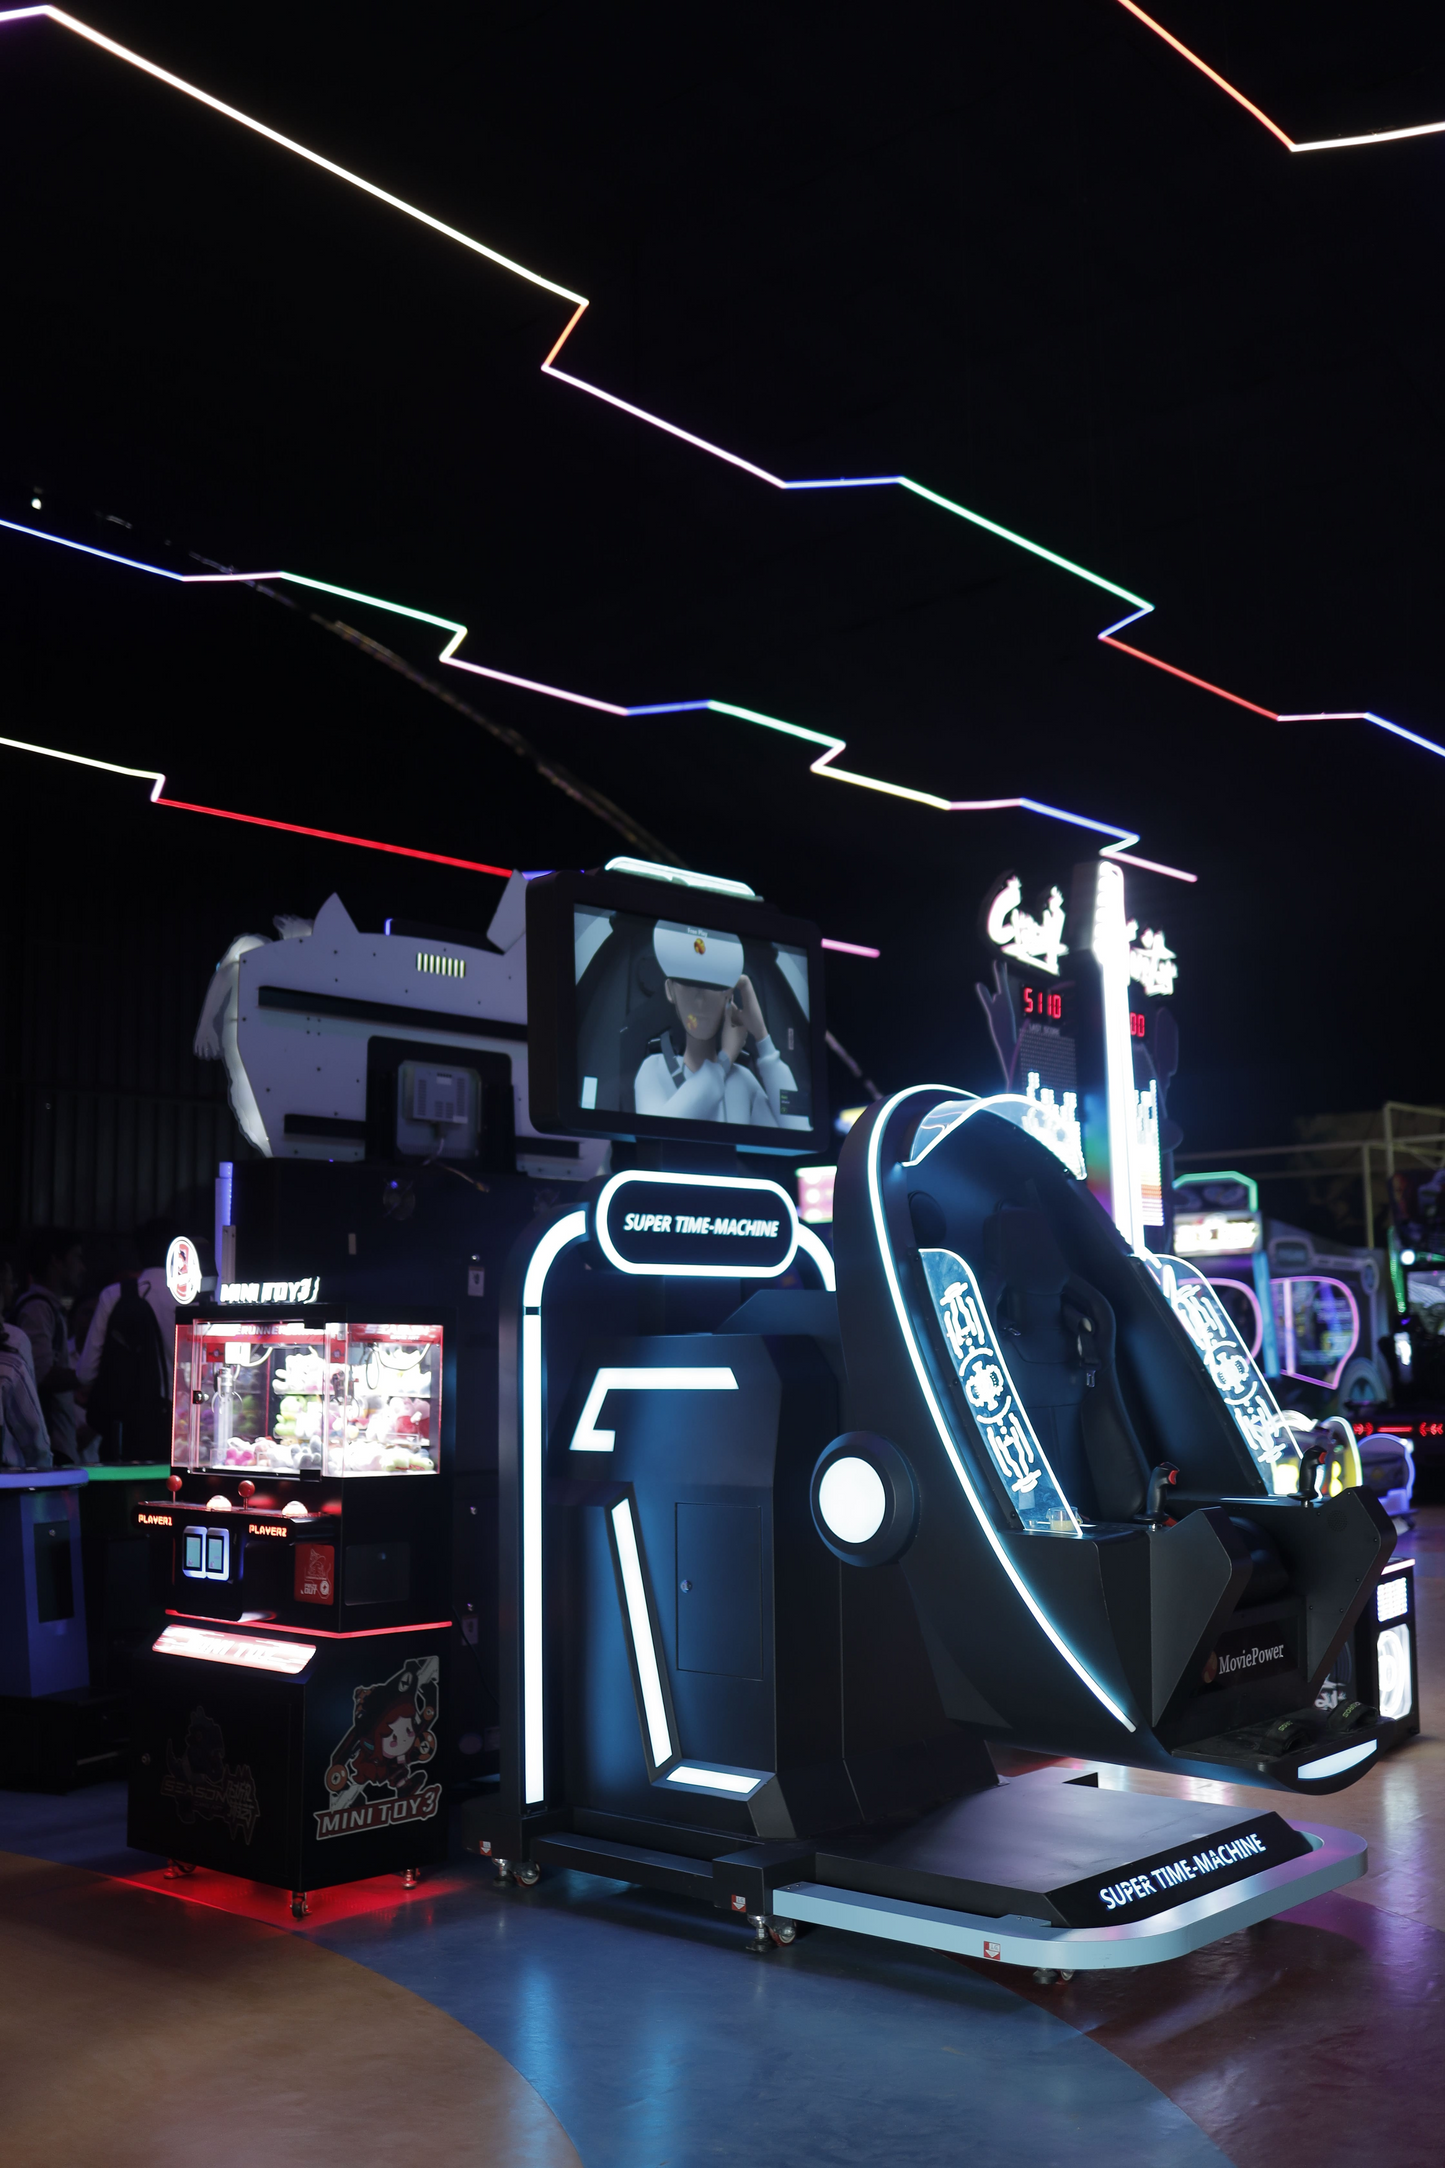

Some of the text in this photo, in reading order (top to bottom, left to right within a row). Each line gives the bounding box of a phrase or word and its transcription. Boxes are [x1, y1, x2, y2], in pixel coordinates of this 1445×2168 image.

[1024, 987, 1061, 1019] 5110
[623, 1212, 780, 1238] SUPER TIME-MACHINE
[220, 1282, 260, 1304] MINI
[138, 1513, 173, 1527] PLAYER1
[249, 1524, 287, 1538] PLAYER2
[1218, 1644, 1284, 1675] MoviePower
[163, 1780, 227, 1803] SEASON
[322, 1805, 373, 1834] MINI
[1099, 1833, 1266, 1910] SUPER TIME-MACHINE
